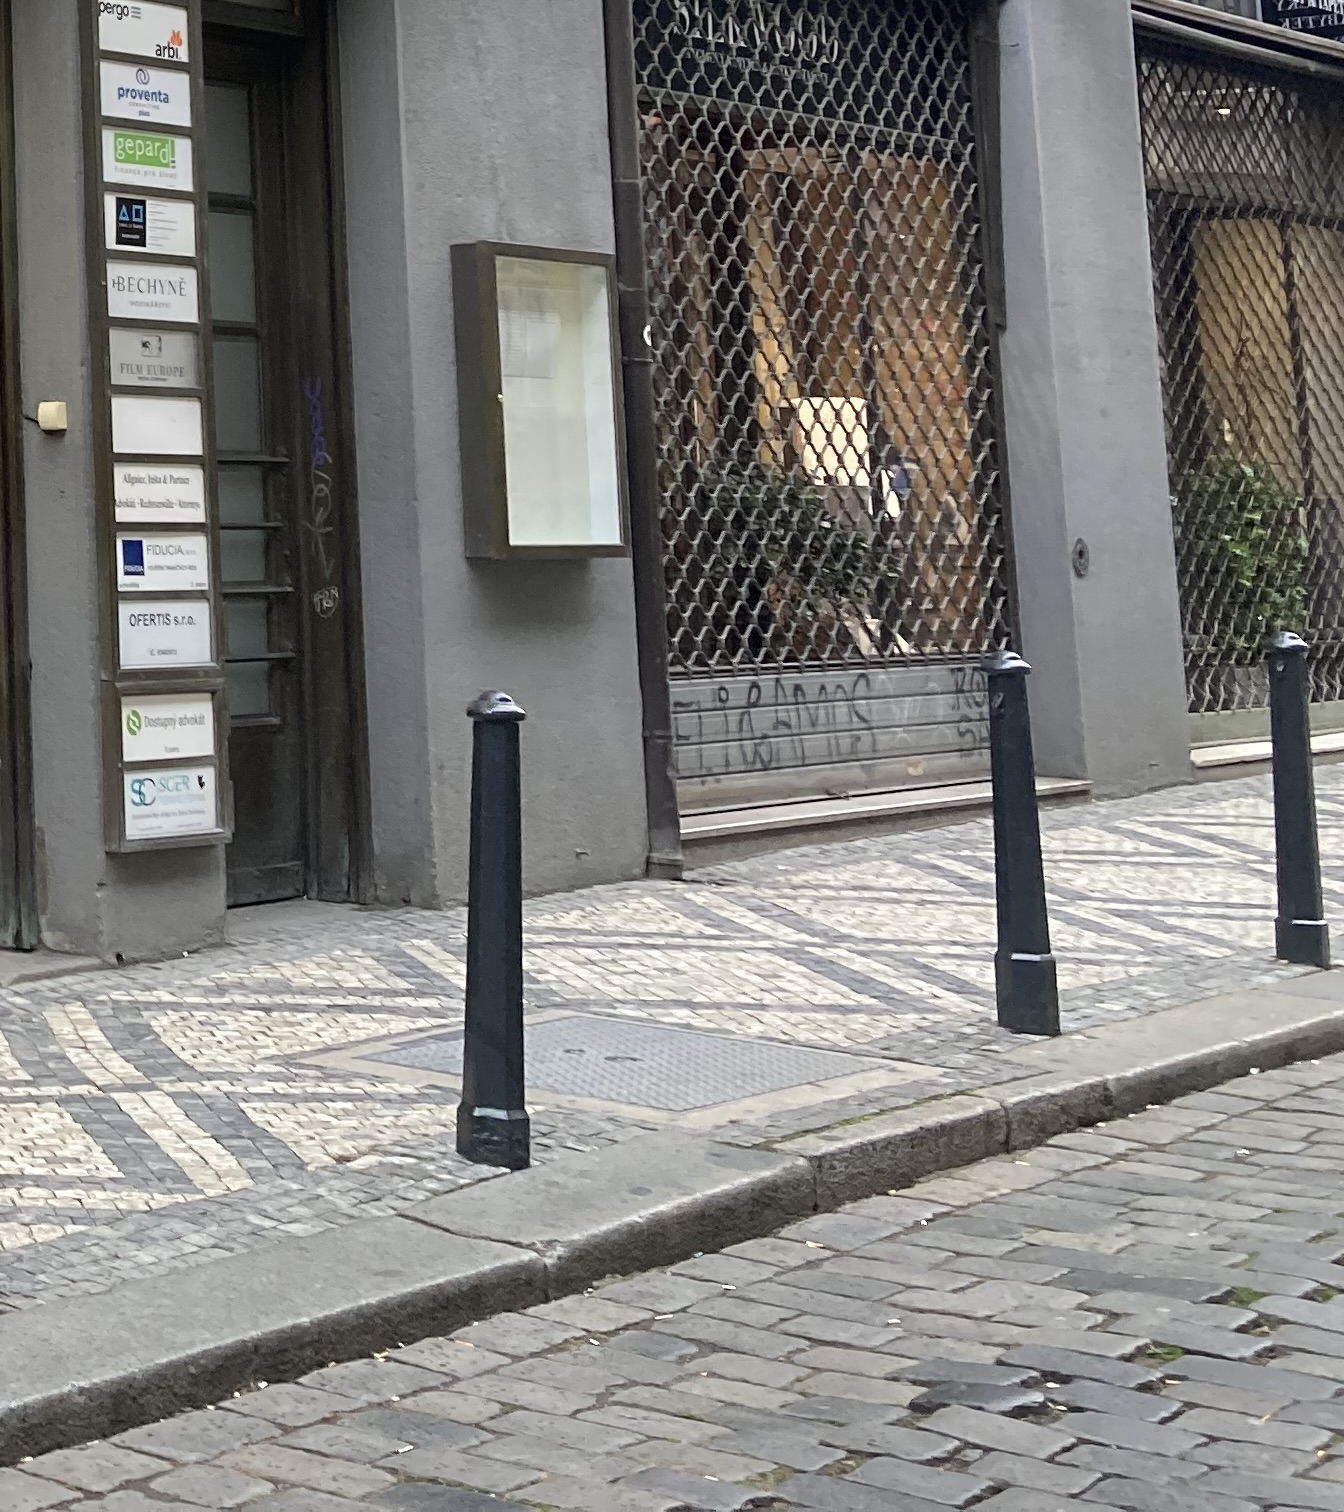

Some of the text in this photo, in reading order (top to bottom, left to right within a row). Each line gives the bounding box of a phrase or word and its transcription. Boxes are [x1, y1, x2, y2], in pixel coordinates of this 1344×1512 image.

[99, 1, 130, 20] pergo
[155, 40, 179, 60] arbi
[117, 87, 169, 104] proventa
[116, 275, 187, 296] BECHYNĚ
[120, 363, 185, 377] FILM EUROPE
[146, 544, 184, 555] FIDUCIA
[129, 613, 196, 627] OFERTIS s.r.o.
[144, 713, 205, 729] Dostupný advokát
